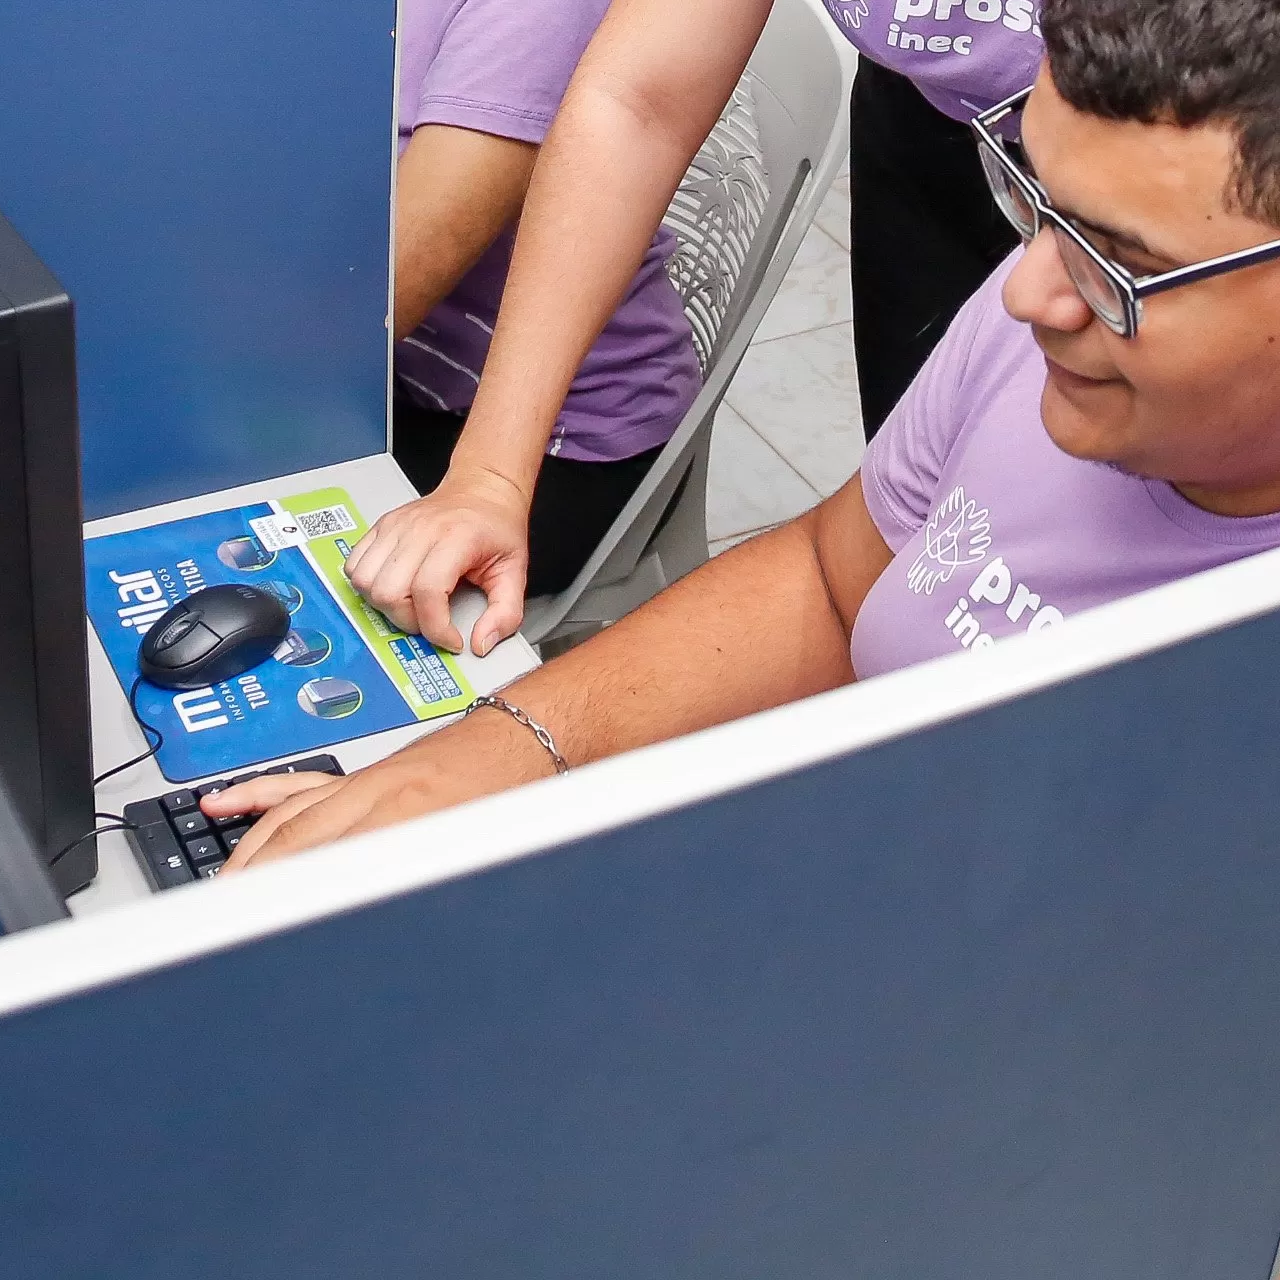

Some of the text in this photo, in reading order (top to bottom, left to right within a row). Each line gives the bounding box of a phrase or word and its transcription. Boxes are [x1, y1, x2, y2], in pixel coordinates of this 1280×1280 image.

[886, 23, 973, 56] inec
[968, 556, 1065, 636] pro
[237, 674, 270, 710] TUDO
